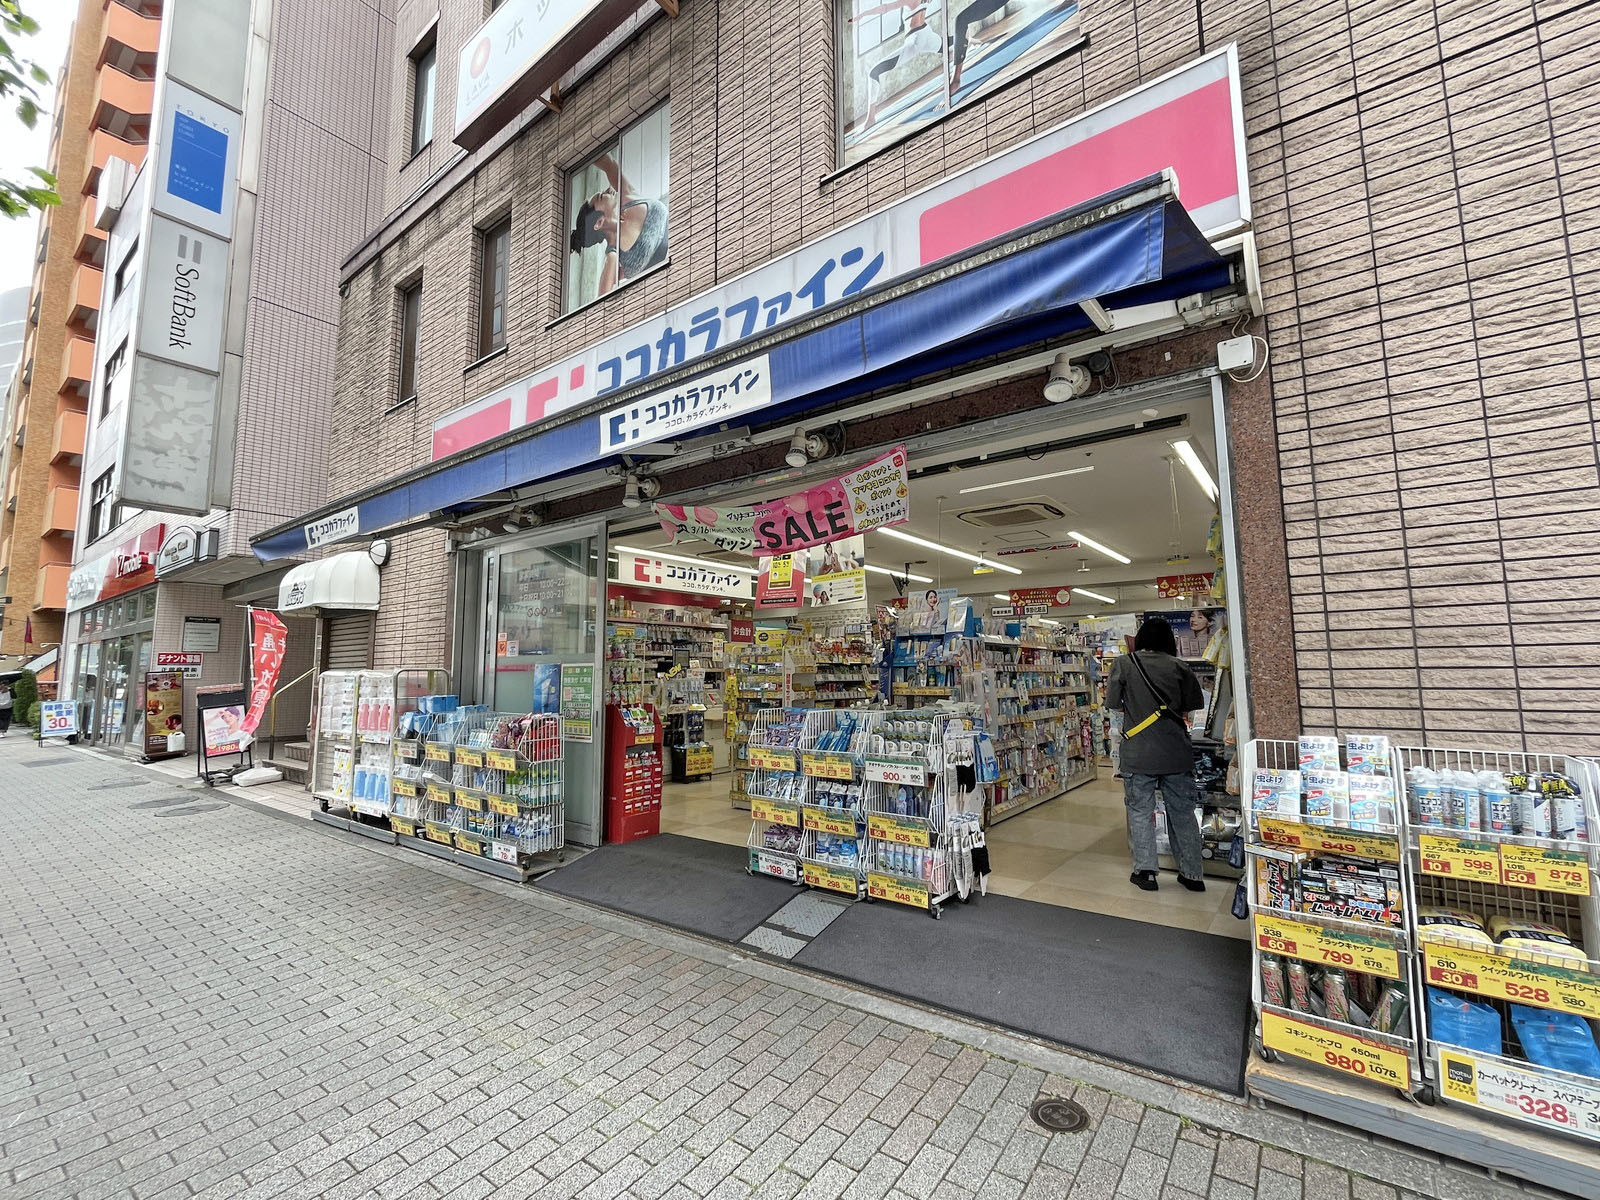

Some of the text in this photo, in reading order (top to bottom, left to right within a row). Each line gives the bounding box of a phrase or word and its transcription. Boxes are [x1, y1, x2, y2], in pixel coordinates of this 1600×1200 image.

[169, 263, 200, 350] SoftBank
[597, 246, 884, 395] ココカラファイン
[645, 369, 760, 425] ココカラファイン
[320, 513, 356, 536] ココカラファイン
[759, 500, 849, 549] SALE
[666, 564, 741, 587] ココカラファイン
[733, 626, 752, 636] お会計
[48, 717, 68, 729] 30
[1348, 743, 1375, 751] 虫よけ
[882, 771, 900, 781] 900
[1257, 775, 1283, 783] 虫よけ
[825, 823, 840, 832] 448
[1320, 840, 1357, 853] 849
[769, 863, 782, 874] 198
[1428, 858, 1494, 871] 10 598
[1508, 869, 1583, 882] 50 878
[827, 879, 841, 889] 298
[895, 892, 911, 902] 448
[1389, 912, 1400, 921] 12
[1263, 927, 1282, 938] 938
[1316, 936, 1374, 953] ブラックキャップ
[1268, 939, 1383, 969] 60 799 878
[1437, 959, 1457, 970] 610
[1480, 965, 1600, 996] クイックルワイパー ドライシート
[1441, 973, 1586, 1008] 30 528 580
[1350, 1046, 1381, 1061] 450ml
[1324, 1050, 1366, 1075] 980
[1449, 1068, 1472, 1079] matsu
[1477, 1069, 1545, 1093] カーペットクリーナー
[1519, 1094, 1569, 1123] 328
